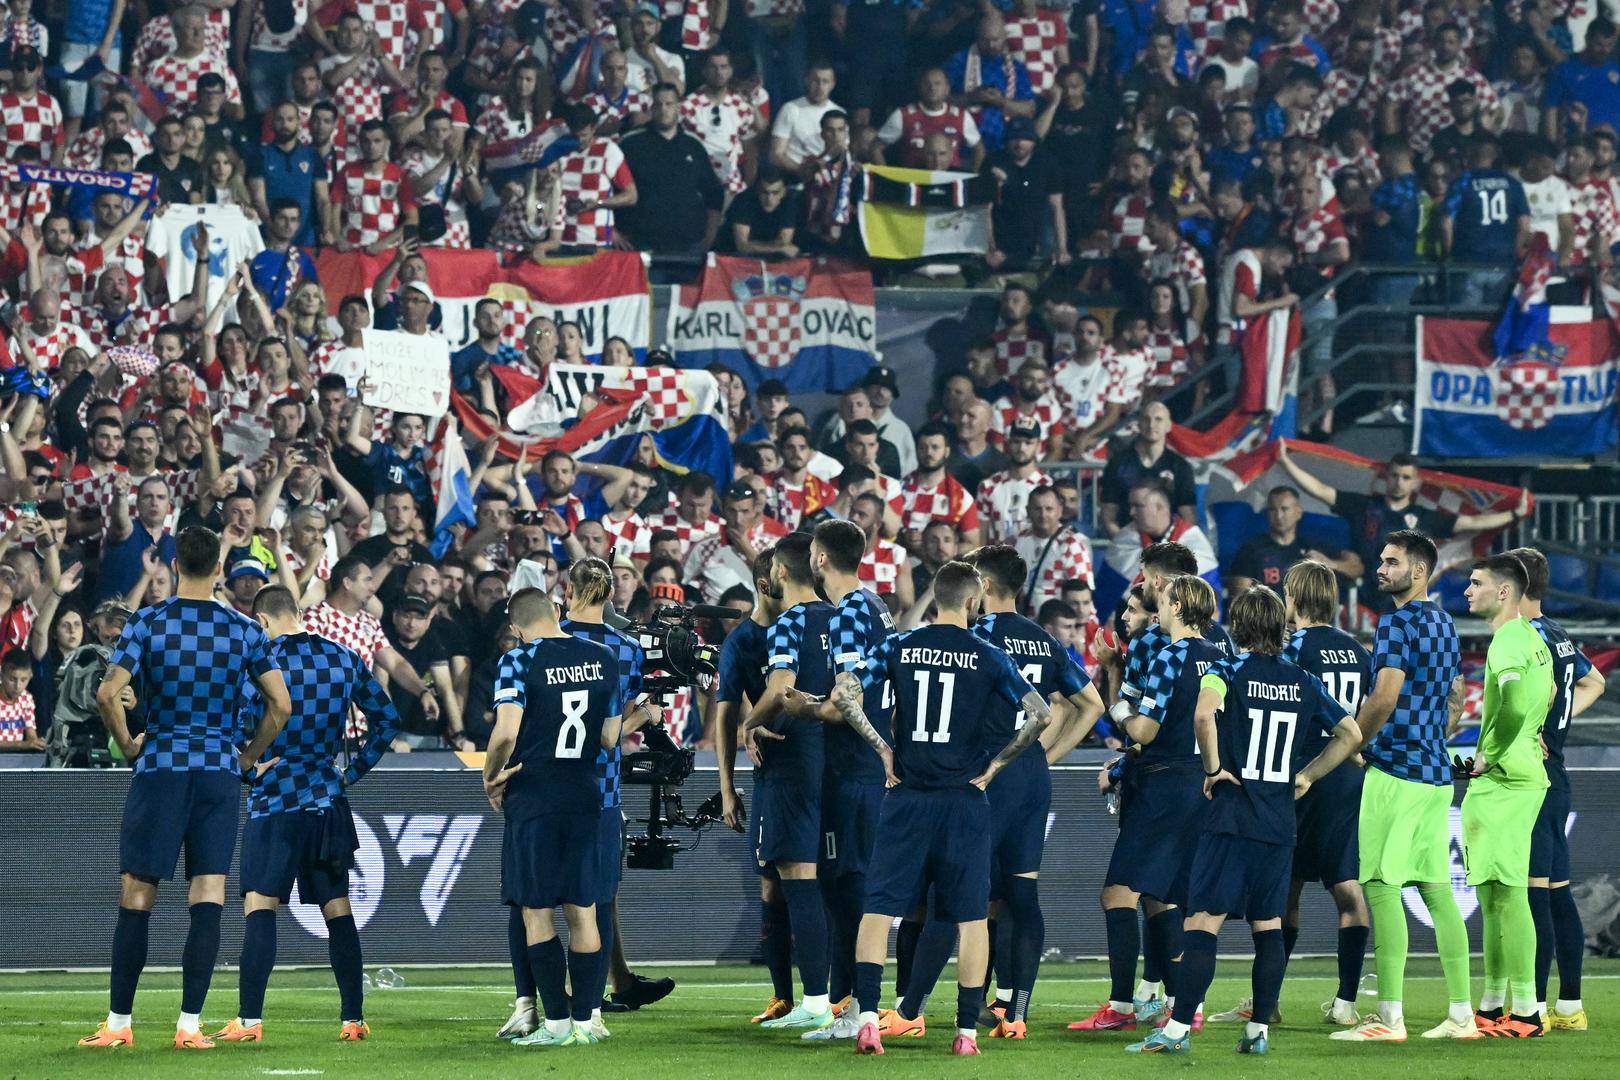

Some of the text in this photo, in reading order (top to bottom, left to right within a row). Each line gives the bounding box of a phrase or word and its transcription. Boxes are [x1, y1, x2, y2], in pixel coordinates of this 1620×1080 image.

[26, 169, 127, 189] CROATIA
[1478, 190, 1508, 225] 14
[674, 309, 873, 341] KARL OVAC
[1431, 371, 1492, 407] OPA
[1264, 567, 1280, 584] 18
[901, 647, 979, 671] BROZOVIĆ
[1004, 636, 1052, 657] ŠUTALO
[1320, 650, 1358, 664] SOSA
[545, 661, 604, 685] KOVAČIĆ
[1247, 680, 1301, 702] MODRIĆ
[1558, 663, 1574, 730] 3
[912, 670, 956, 743] 11
[555, 690, 589, 758] 8
[1241, 708, 1298, 783] 10
